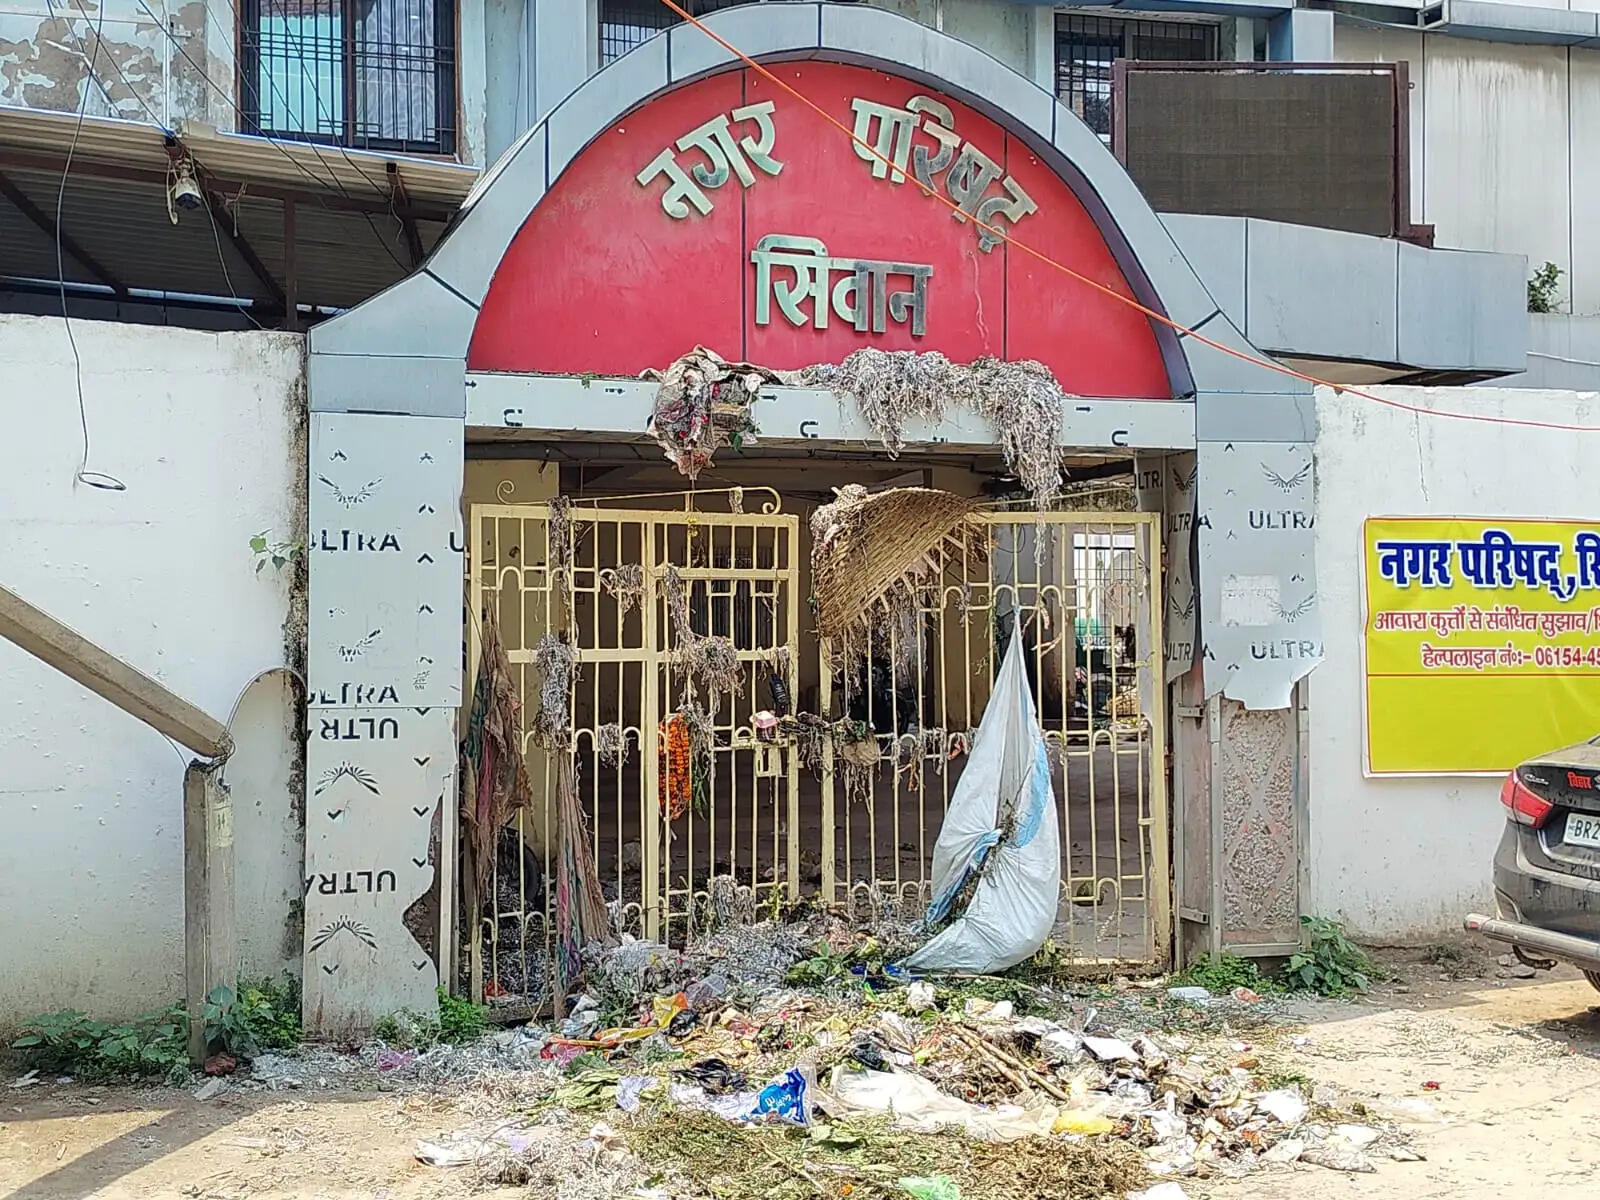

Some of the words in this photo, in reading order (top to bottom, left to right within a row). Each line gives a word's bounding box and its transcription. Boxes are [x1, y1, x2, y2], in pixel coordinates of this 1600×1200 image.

[635, 100, 784, 219] नगर
[750, 234, 934, 336] सिवान
[1377, 541, 1452, 585] नगर
[1374, 611, 1428, 630] आवारा
[1429, 605, 1466, 637] कुत्तों
[1468, 606, 1483, 630] से
[1485, 605, 1539, 630] संबंधित
[1421, 642, 1497, 670] हेल्पलाइन
[307, 717, 399, 740] ULTR
